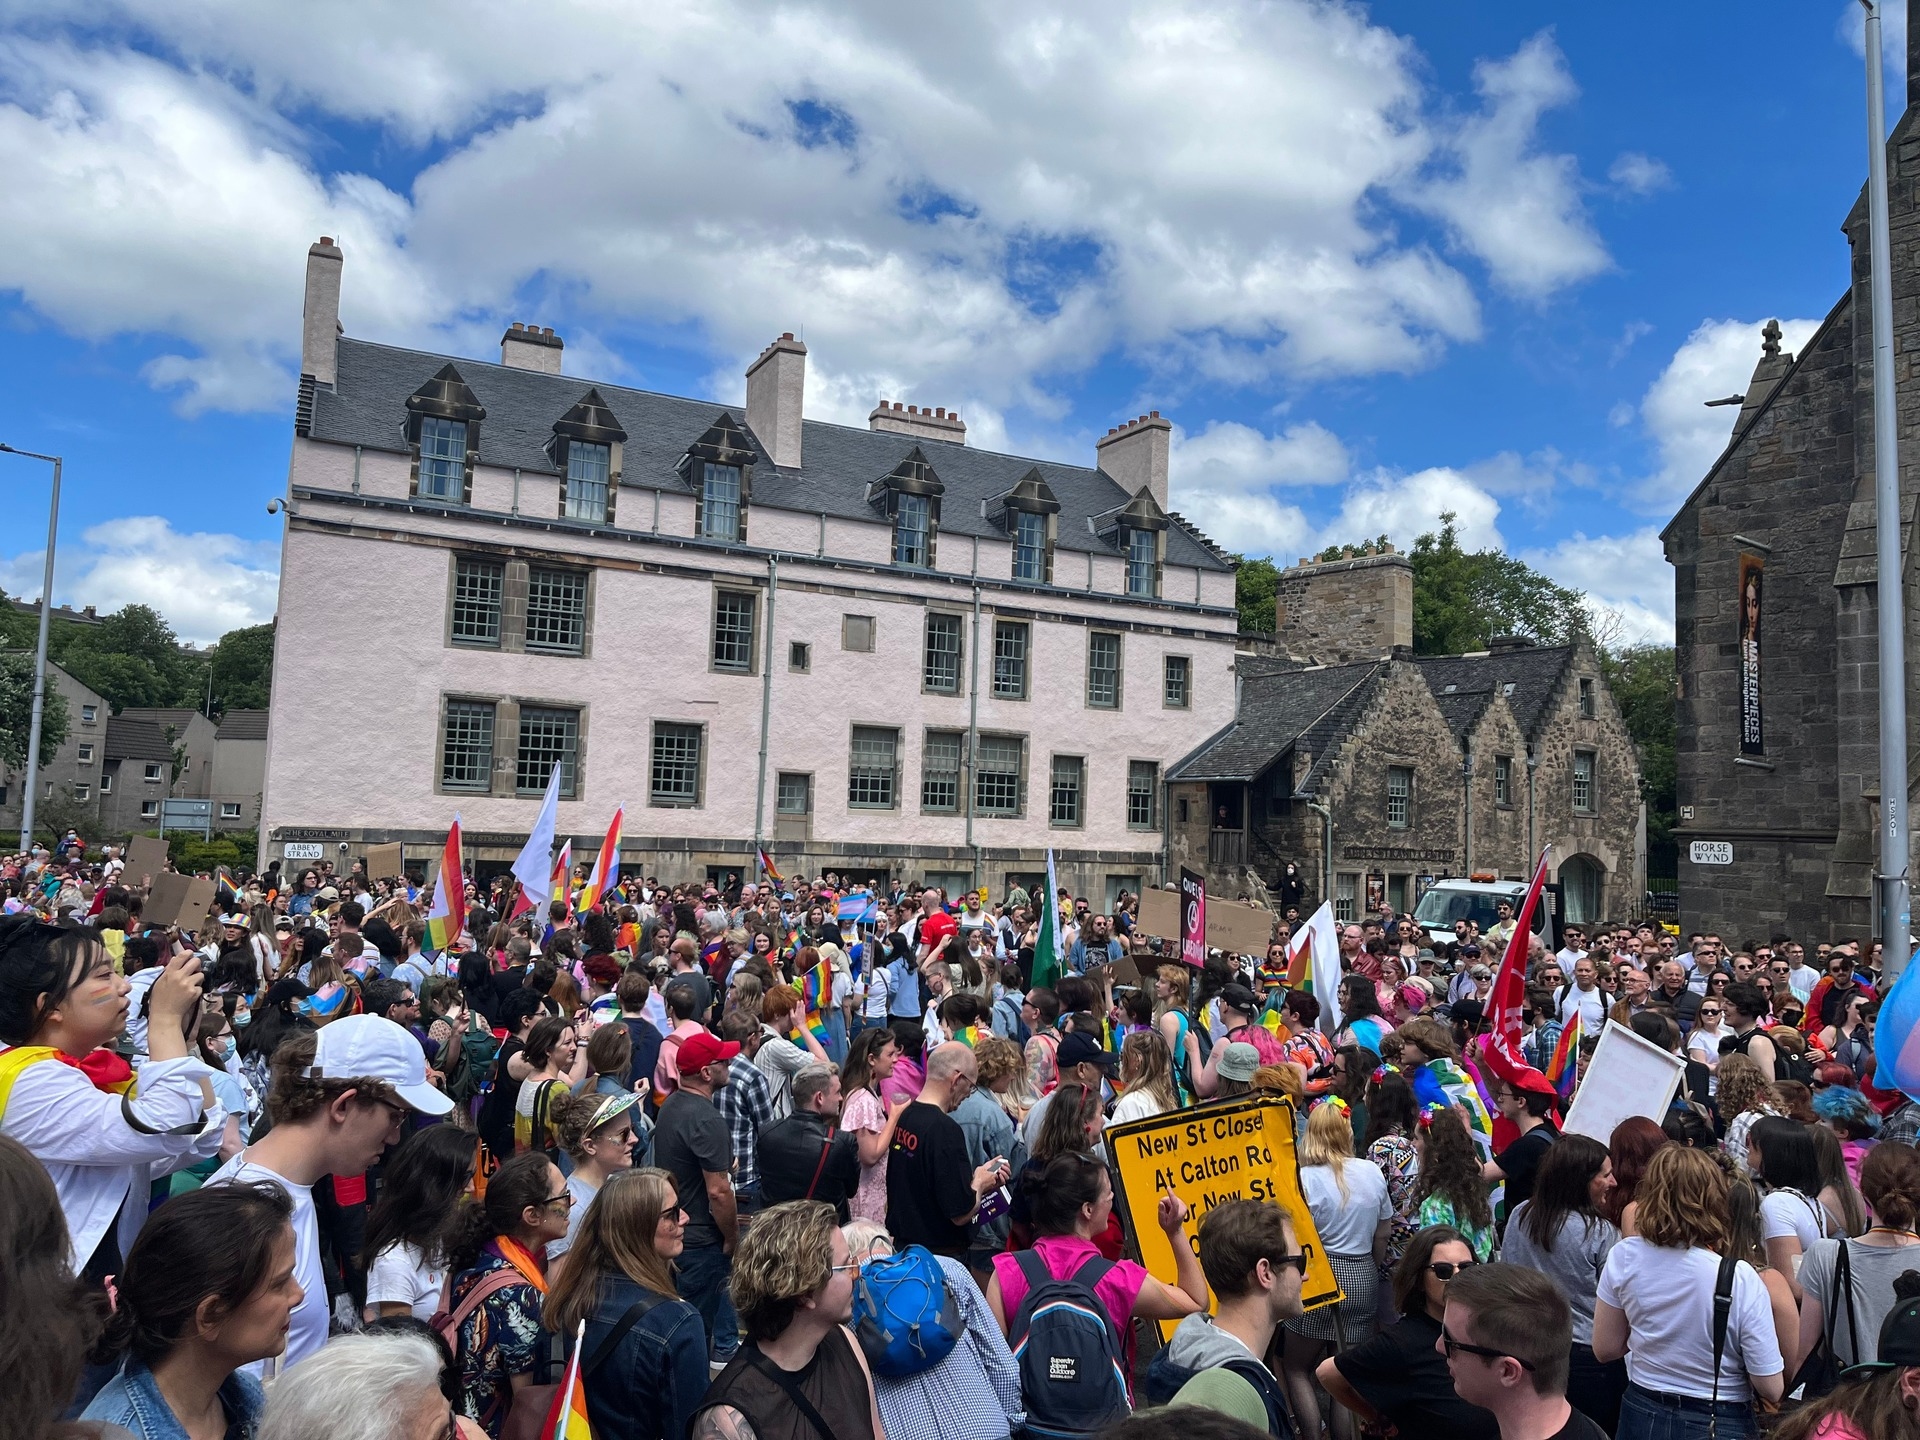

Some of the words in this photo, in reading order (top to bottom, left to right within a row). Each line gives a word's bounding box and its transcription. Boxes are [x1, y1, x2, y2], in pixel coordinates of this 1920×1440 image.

[1749, 640, 1760, 744] MASTERPIECES
[478, 835, 512, 843] STRAND
[1694, 843, 1728, 852] HORSE
[1694, 853, 1729, 862] WYND
[1137, 1133, 1178, 1159] New
[1186, 1122, 1207, 1147] St
[1155, 1166, 1176, 1192] At
[1181, 1153, 1240, 1184] Calton
[1245, 1142, 1273, 1167] Rd
[1249, 1177, 1276, 1201] St
